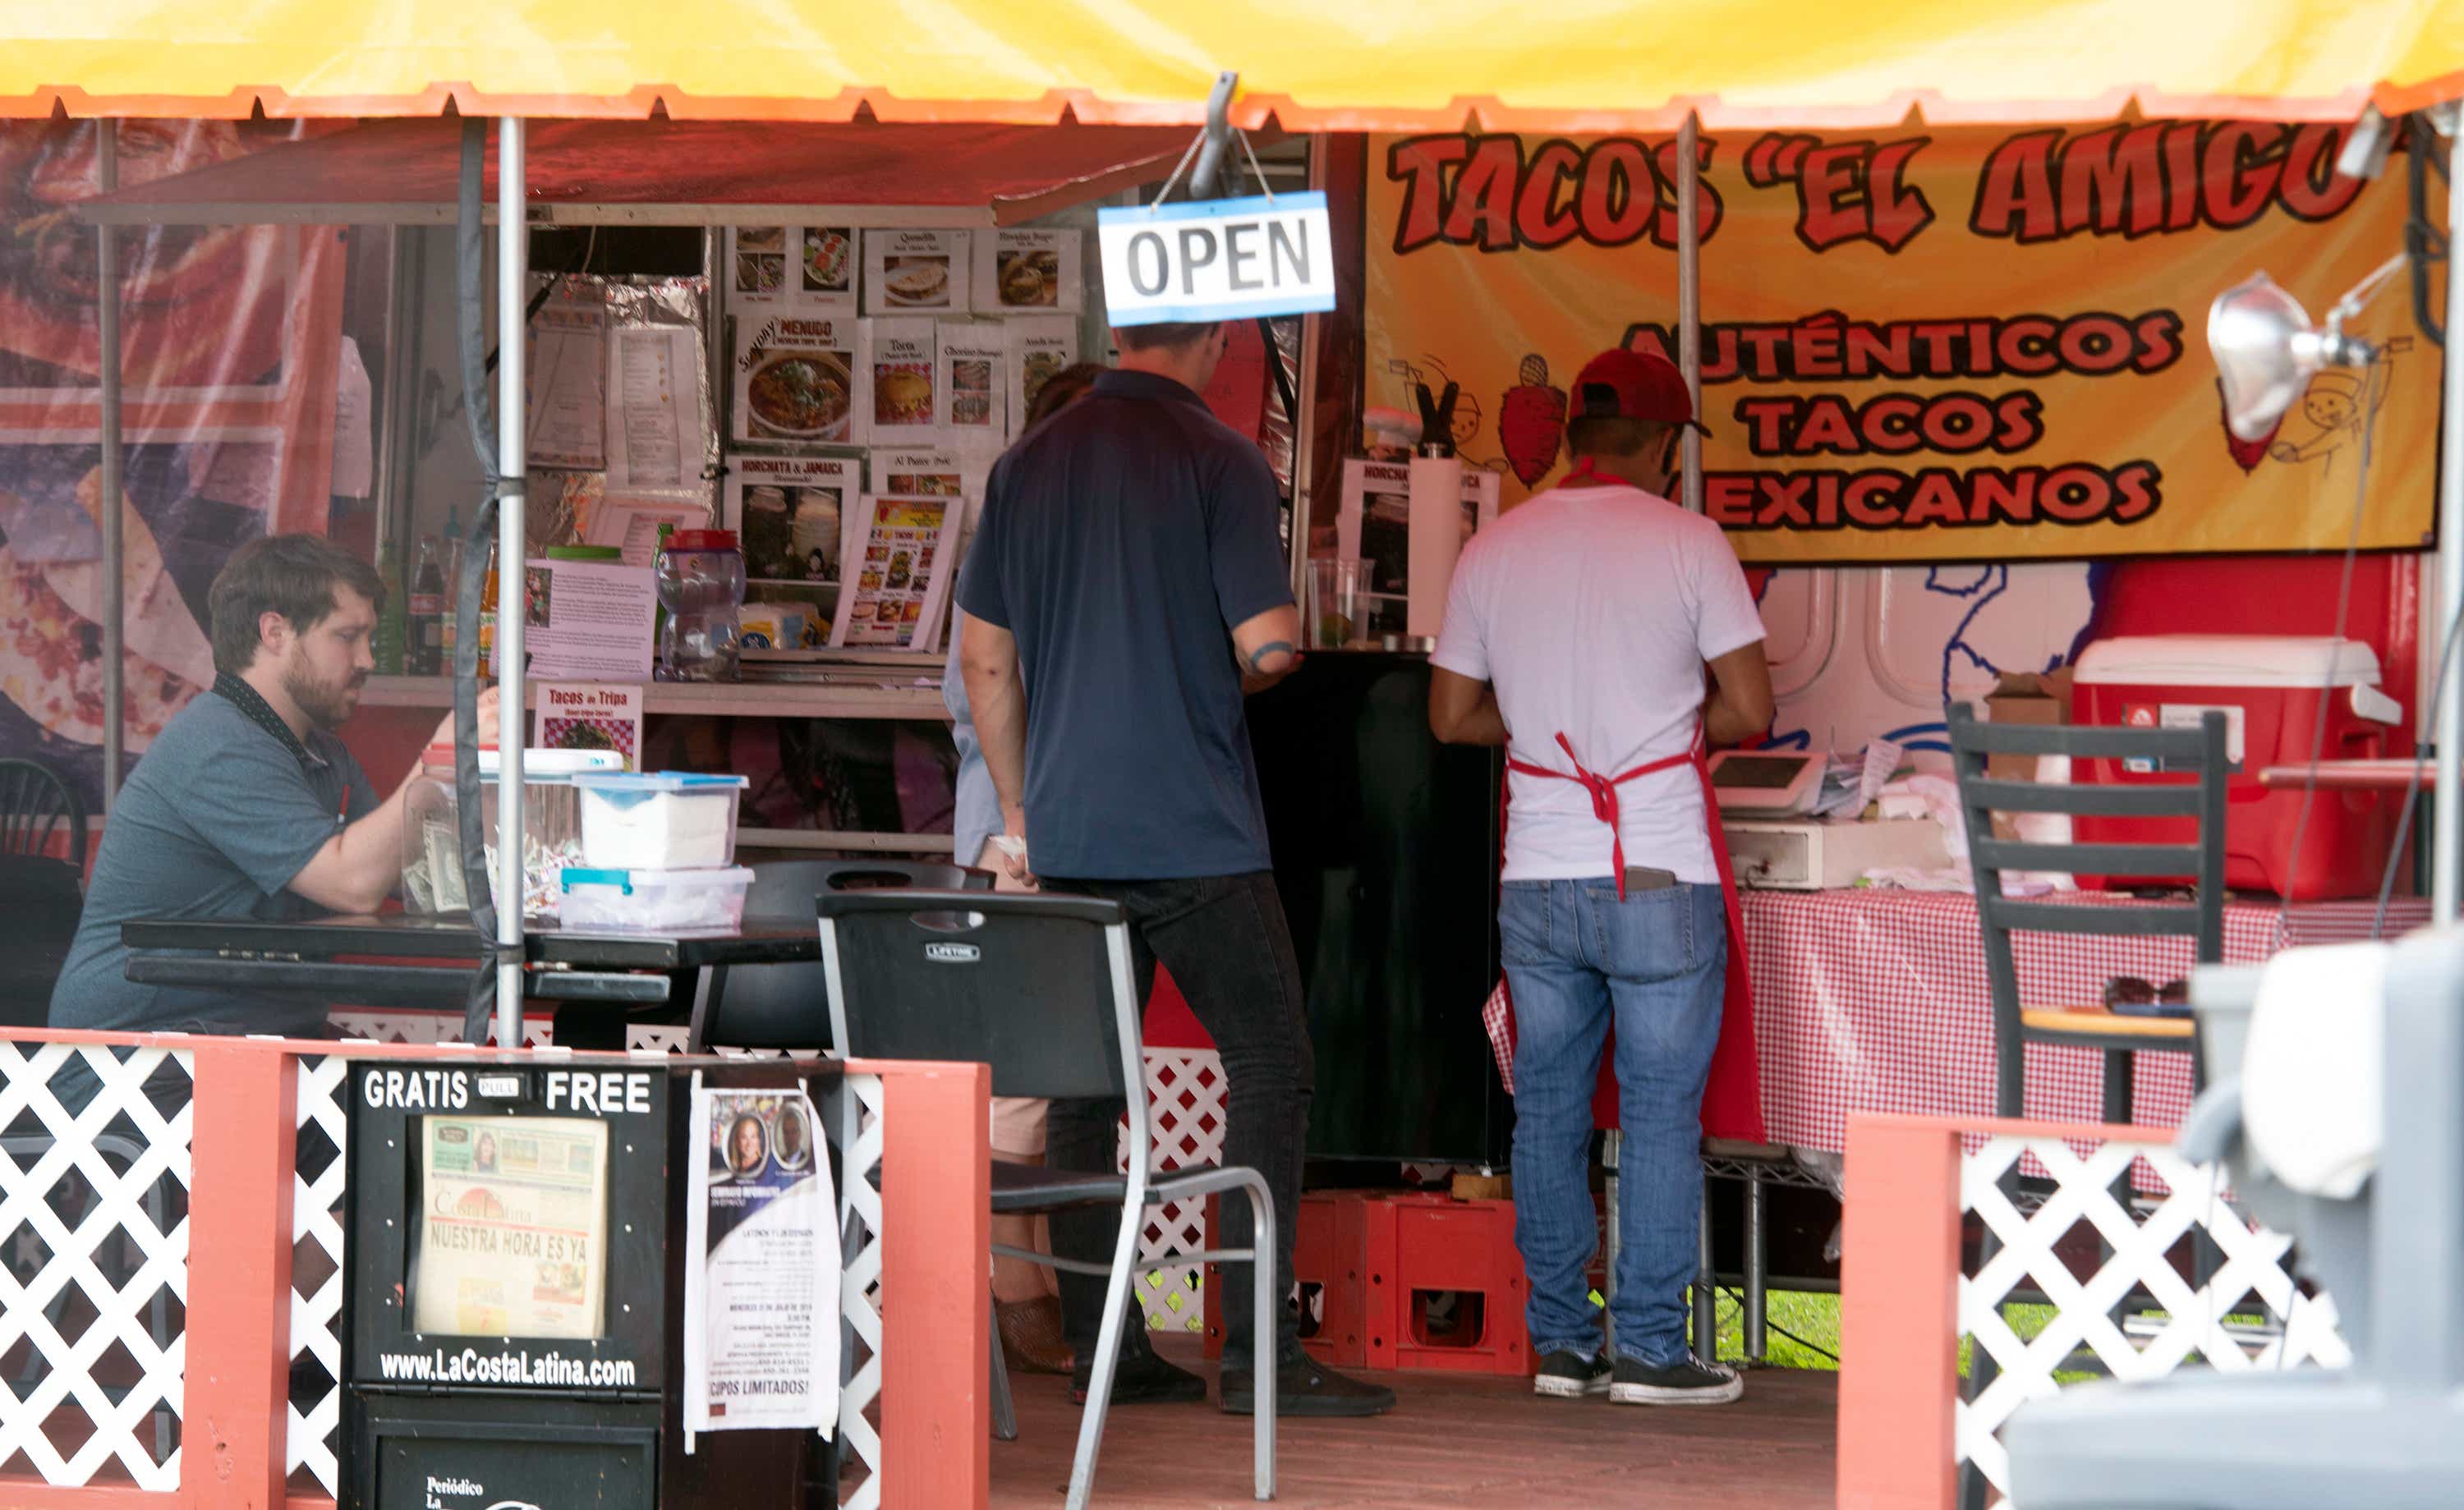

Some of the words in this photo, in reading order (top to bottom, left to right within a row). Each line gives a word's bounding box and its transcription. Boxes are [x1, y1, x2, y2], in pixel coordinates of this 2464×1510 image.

[1386, 133, 1723, 255] TACOS
[1968, 120, 2412, 246] AMIGO
[1127, 218, 1312, 297] OPEN
[780, 319, 832, 336] MENUDO
[1733, 389, 2045, 457] TACOS
[742, 460, 791, 474] HORCHATA
[1364, 464, 1410, 481] HORCHA
[549, 689, 584, 705] Tacos
[599, 691, 627, 706] Tripa
[364, 1070, 469, 1109] GRATIS
[545, 1071, 651, 1113] FREE
[430, 1221, 497, 1254] NUESTRA
[503, 1227, 541, 1259] HORA
[546, 1234, 564, 1261] ES
[569, 1237, 587, 1263] YA
[379, 1348, 636, 1386] www.LaCostaLatina.com
[426, 1476, 485, 1497] Periódico
[425, 1493, 443, 1510] La
